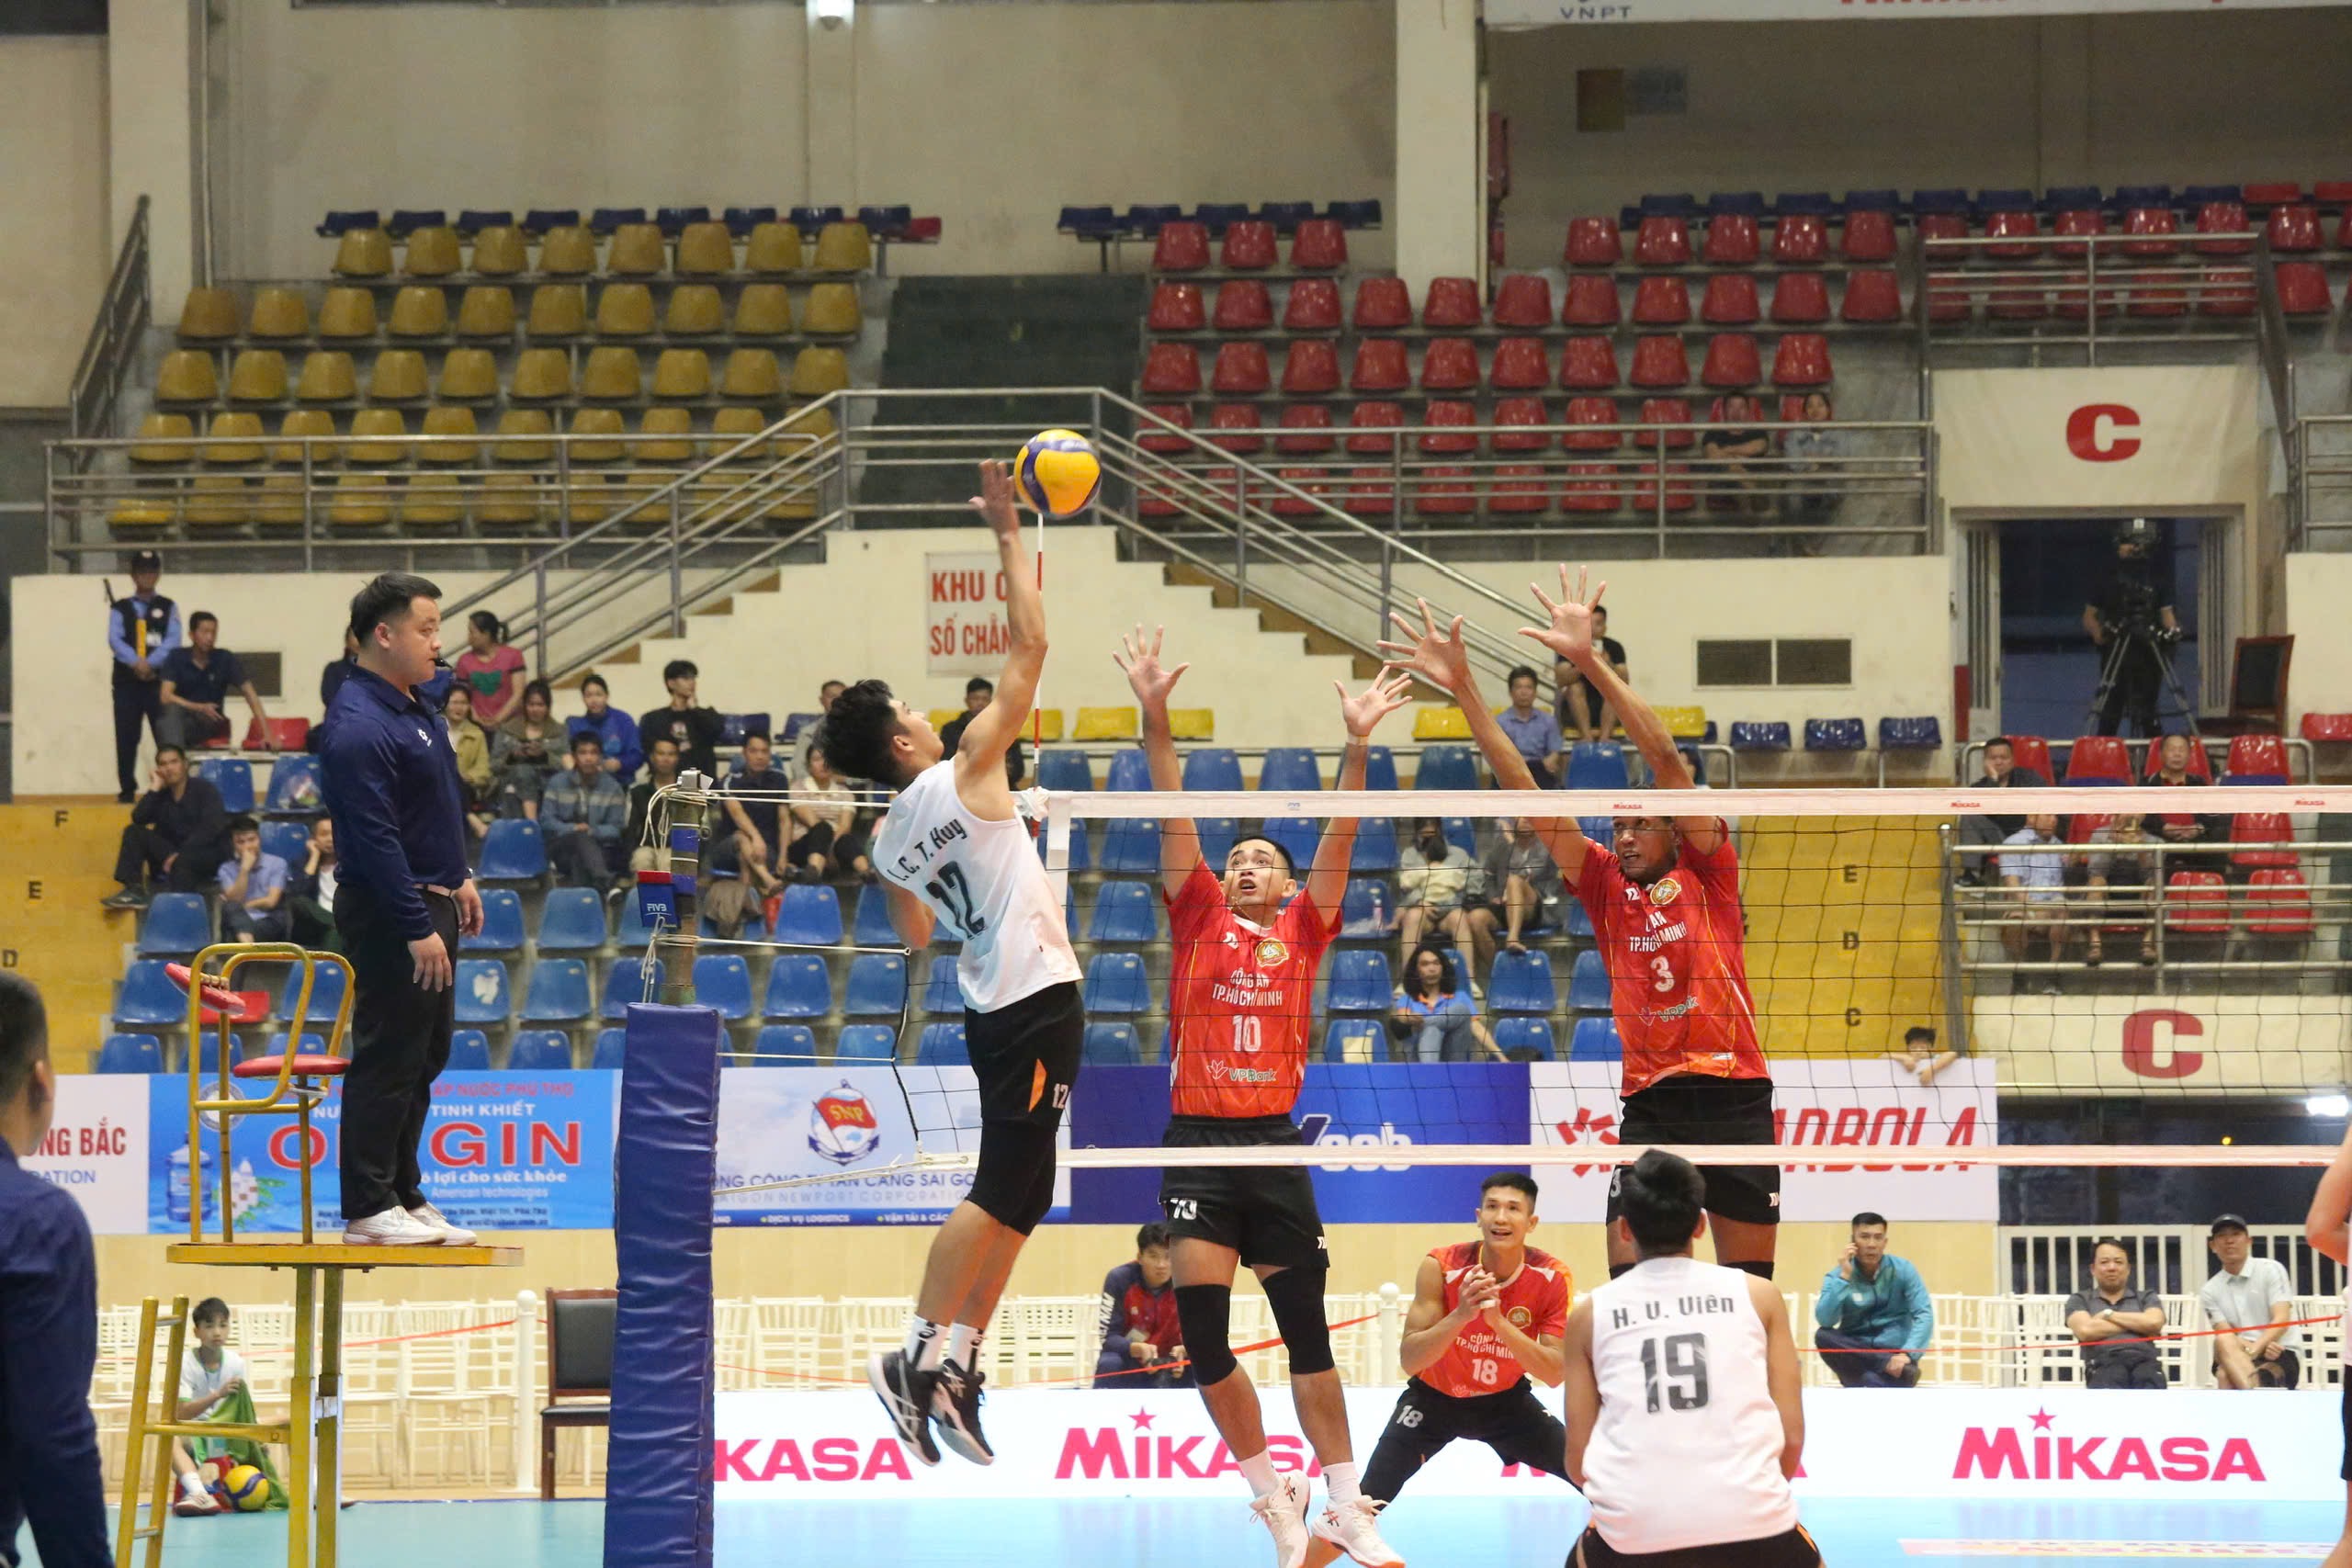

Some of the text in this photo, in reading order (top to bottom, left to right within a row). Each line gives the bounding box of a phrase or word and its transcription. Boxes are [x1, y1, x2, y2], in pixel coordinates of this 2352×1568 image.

[1560, 6, 1632, 20] VNPT
[2066, 403, 2141, 462] C
[931, 570, 986, 603] KHU
[930, 613, 956, 656] SỐ
[54, 810, 69, 828] F
[914, 840, 934, 863] T.
[930, 818, 967, 851] Huy
[1843, 863, 1858, 884] E
[28, 881, 42, 899] E
[646, 903, 668, 912] FIVB
[1842, 931, 1860, 951] D
[2, 949, 18, 968] D
[1650, 954, 1676, 993] 3
[1845, 1007, 1861, 1027] C
[1232, 1014, 1261, 1052] 10
[2122, 1009, 2204, 1079] C
[1228, 1067, 1278, 1082] VPBank
[430, 1102, 475, 1118] TINH
[479, 1099, 537, 1118] KHIẾT
[1052, 1083, 1069, 1110] 12
[830, 1104, 865, 1122] SNP
[79, 1116, 127, 1156] BẮC
[267, 1121, 582, 1169] OGIN
[459, 1170, 491, 1184] cho
[1612, 1307, 1637, 1329] H.
[1472, 1358, 1498, 1385] 18
[1640, 1332, 1709, 1415] 19
[1396, 1404, 1424, 1438] 18
[712, 1437, 913, 1482] KASA
[1952, 1413, 2267, 1482] MIKASA
